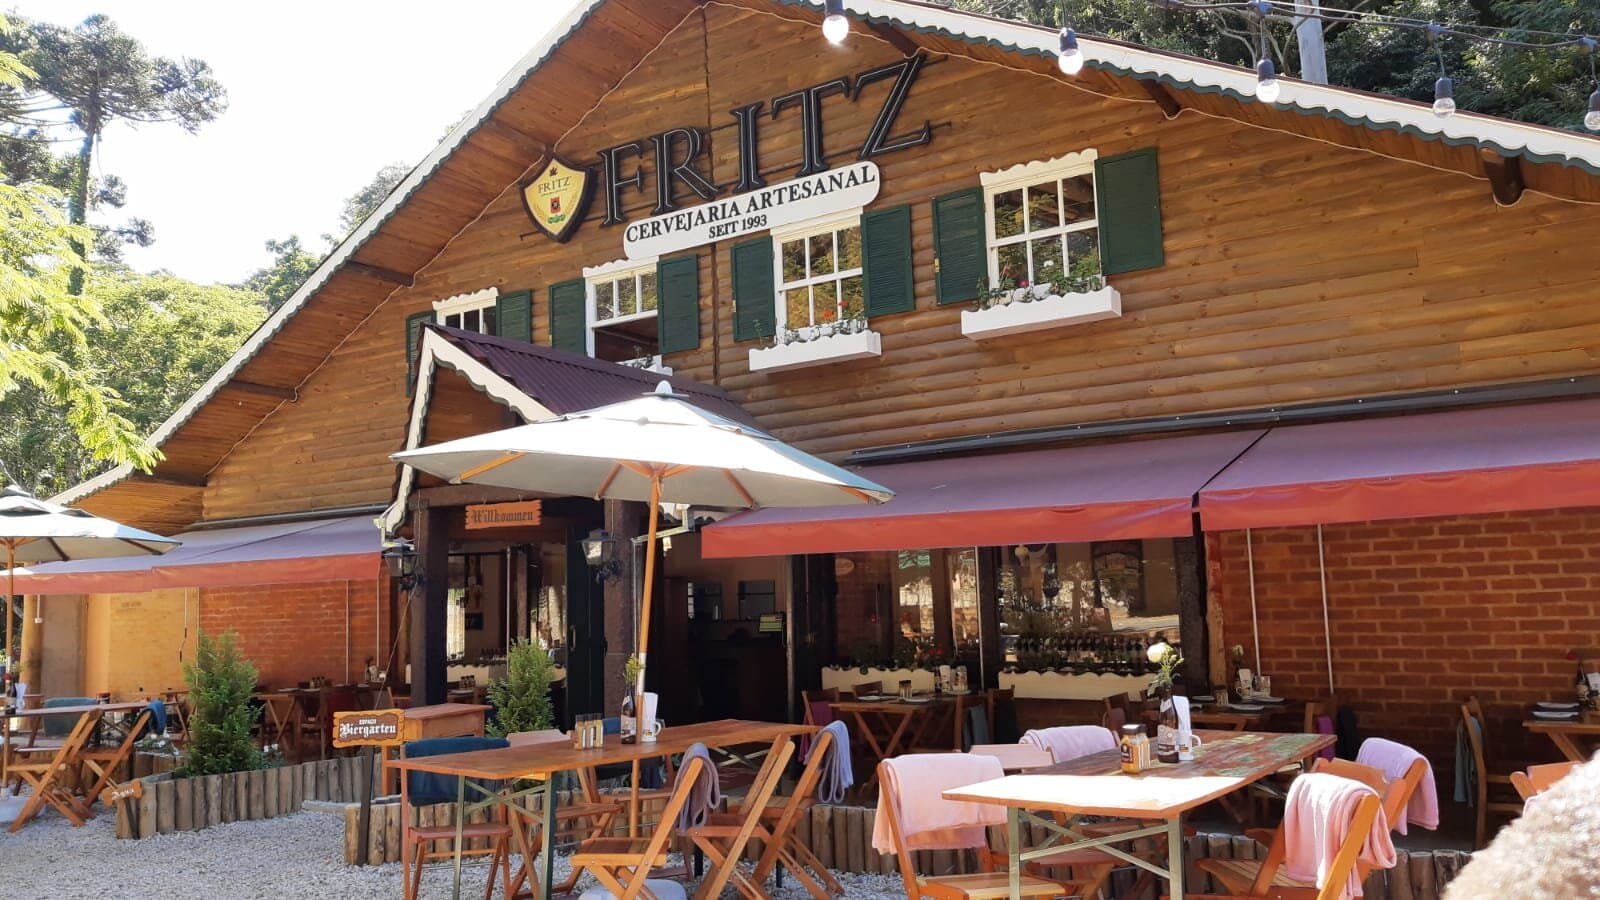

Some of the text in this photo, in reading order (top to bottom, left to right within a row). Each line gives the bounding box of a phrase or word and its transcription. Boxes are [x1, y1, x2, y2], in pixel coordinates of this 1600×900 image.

[598, 55, 929, 226] FRITZ
[538, 177, 571, 193] FRITZ
[626, 165, 876, 243] CERVEJARIA ARTESANAL
[708, 214, 768, 239] SEIT 1993
[473, 509, 532, 523] Willkommen
[340, 723, 396, 738] Biergarten
